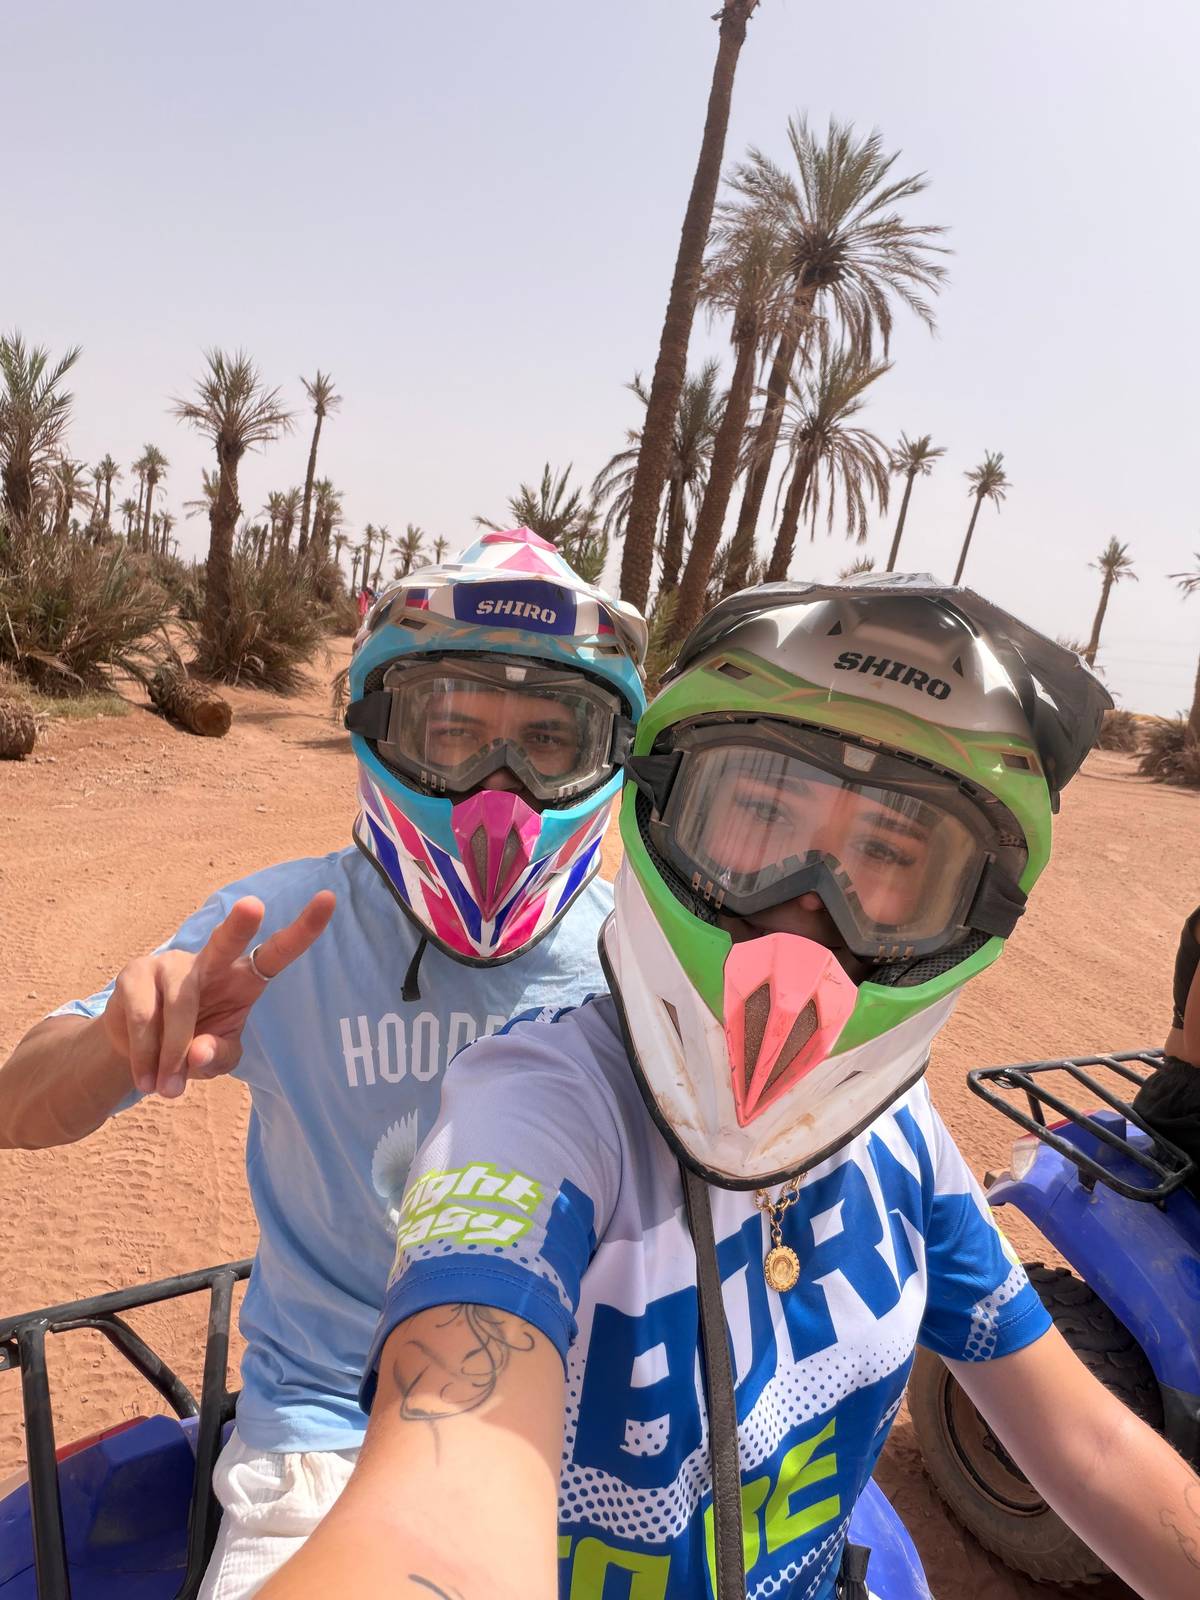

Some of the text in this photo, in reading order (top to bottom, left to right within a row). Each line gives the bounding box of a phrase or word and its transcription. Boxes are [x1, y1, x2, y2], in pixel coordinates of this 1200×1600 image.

[476, 600, 557, 624] SHIRO
[833, 652, 951, 700] SHIRO
[339, 1011, 508, 1087] HOOD
